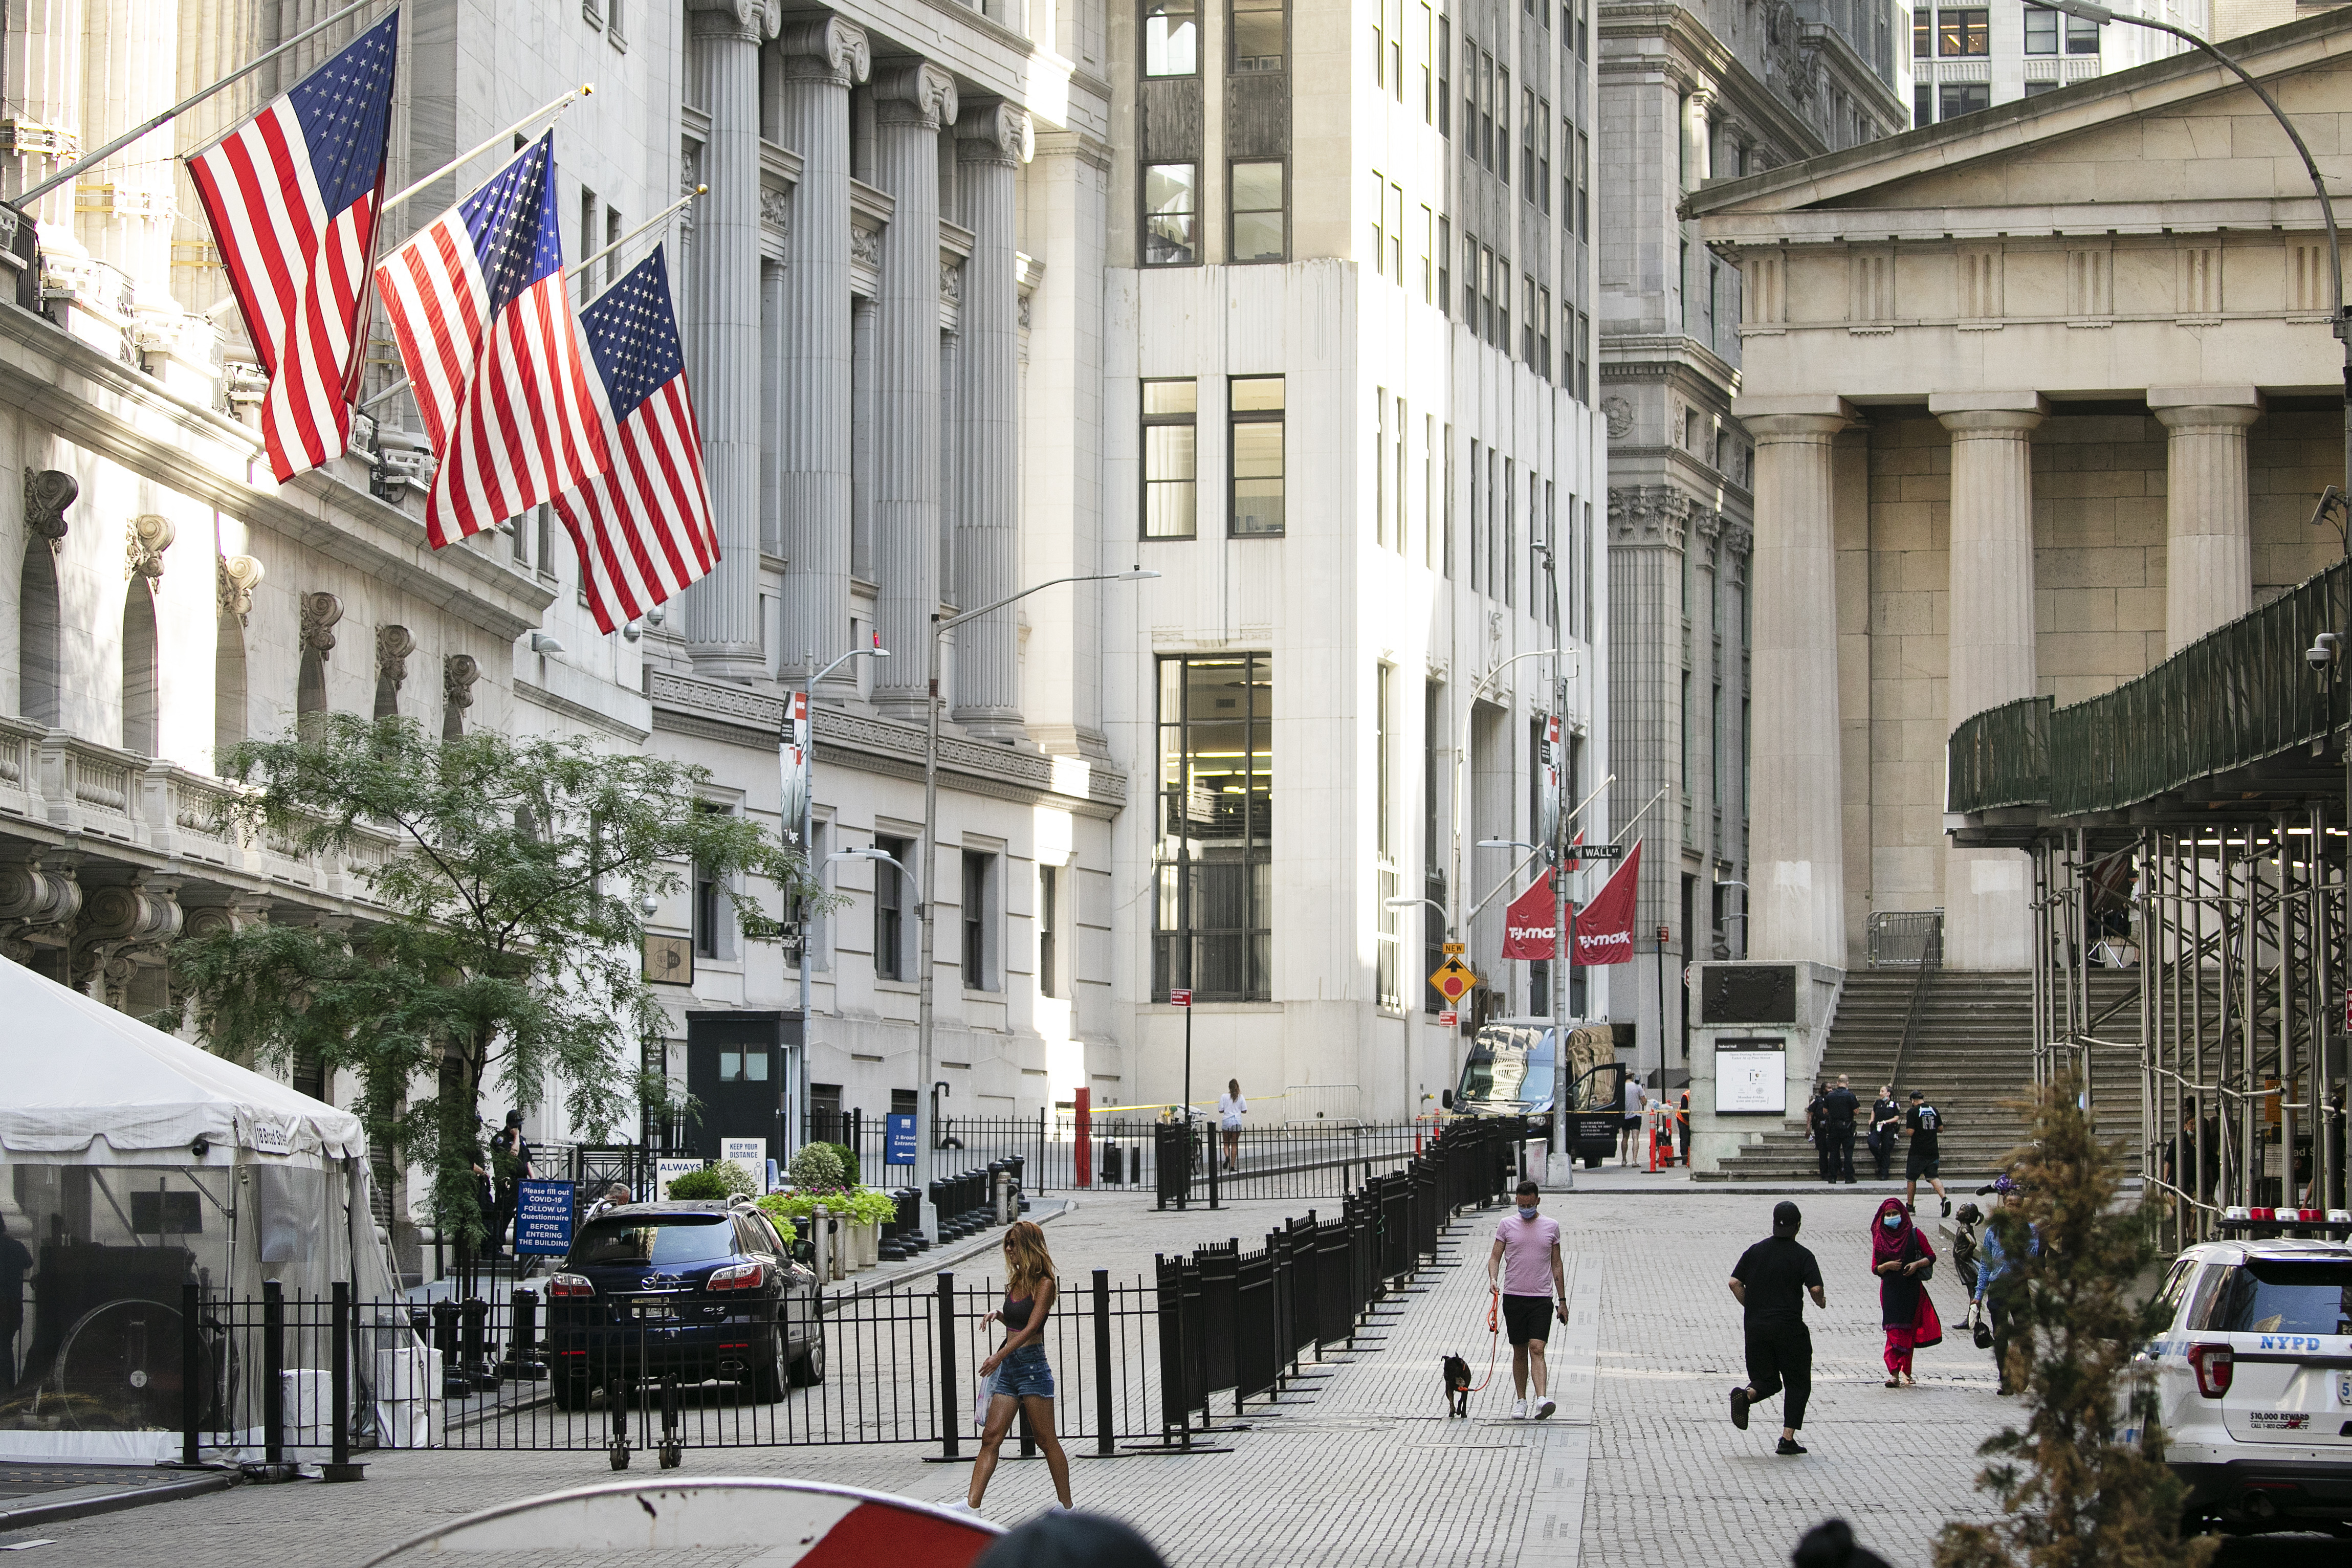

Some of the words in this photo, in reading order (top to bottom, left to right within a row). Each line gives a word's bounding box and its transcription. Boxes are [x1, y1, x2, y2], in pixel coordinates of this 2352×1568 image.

[789, 828, 799, 844] bgc
[1586, 847, 1612, 857] WALL
[782, 939, 795, 948] BROAD
[257, 1128, 263, 1144] 18
[263, 1128, 276, 1145] Broad
[521, 1213, 568, 1221] Questionnaire
[2260, 1336, 2320, 1351] NYPD
[2250, 1412, 2278, 1421] $10,000
